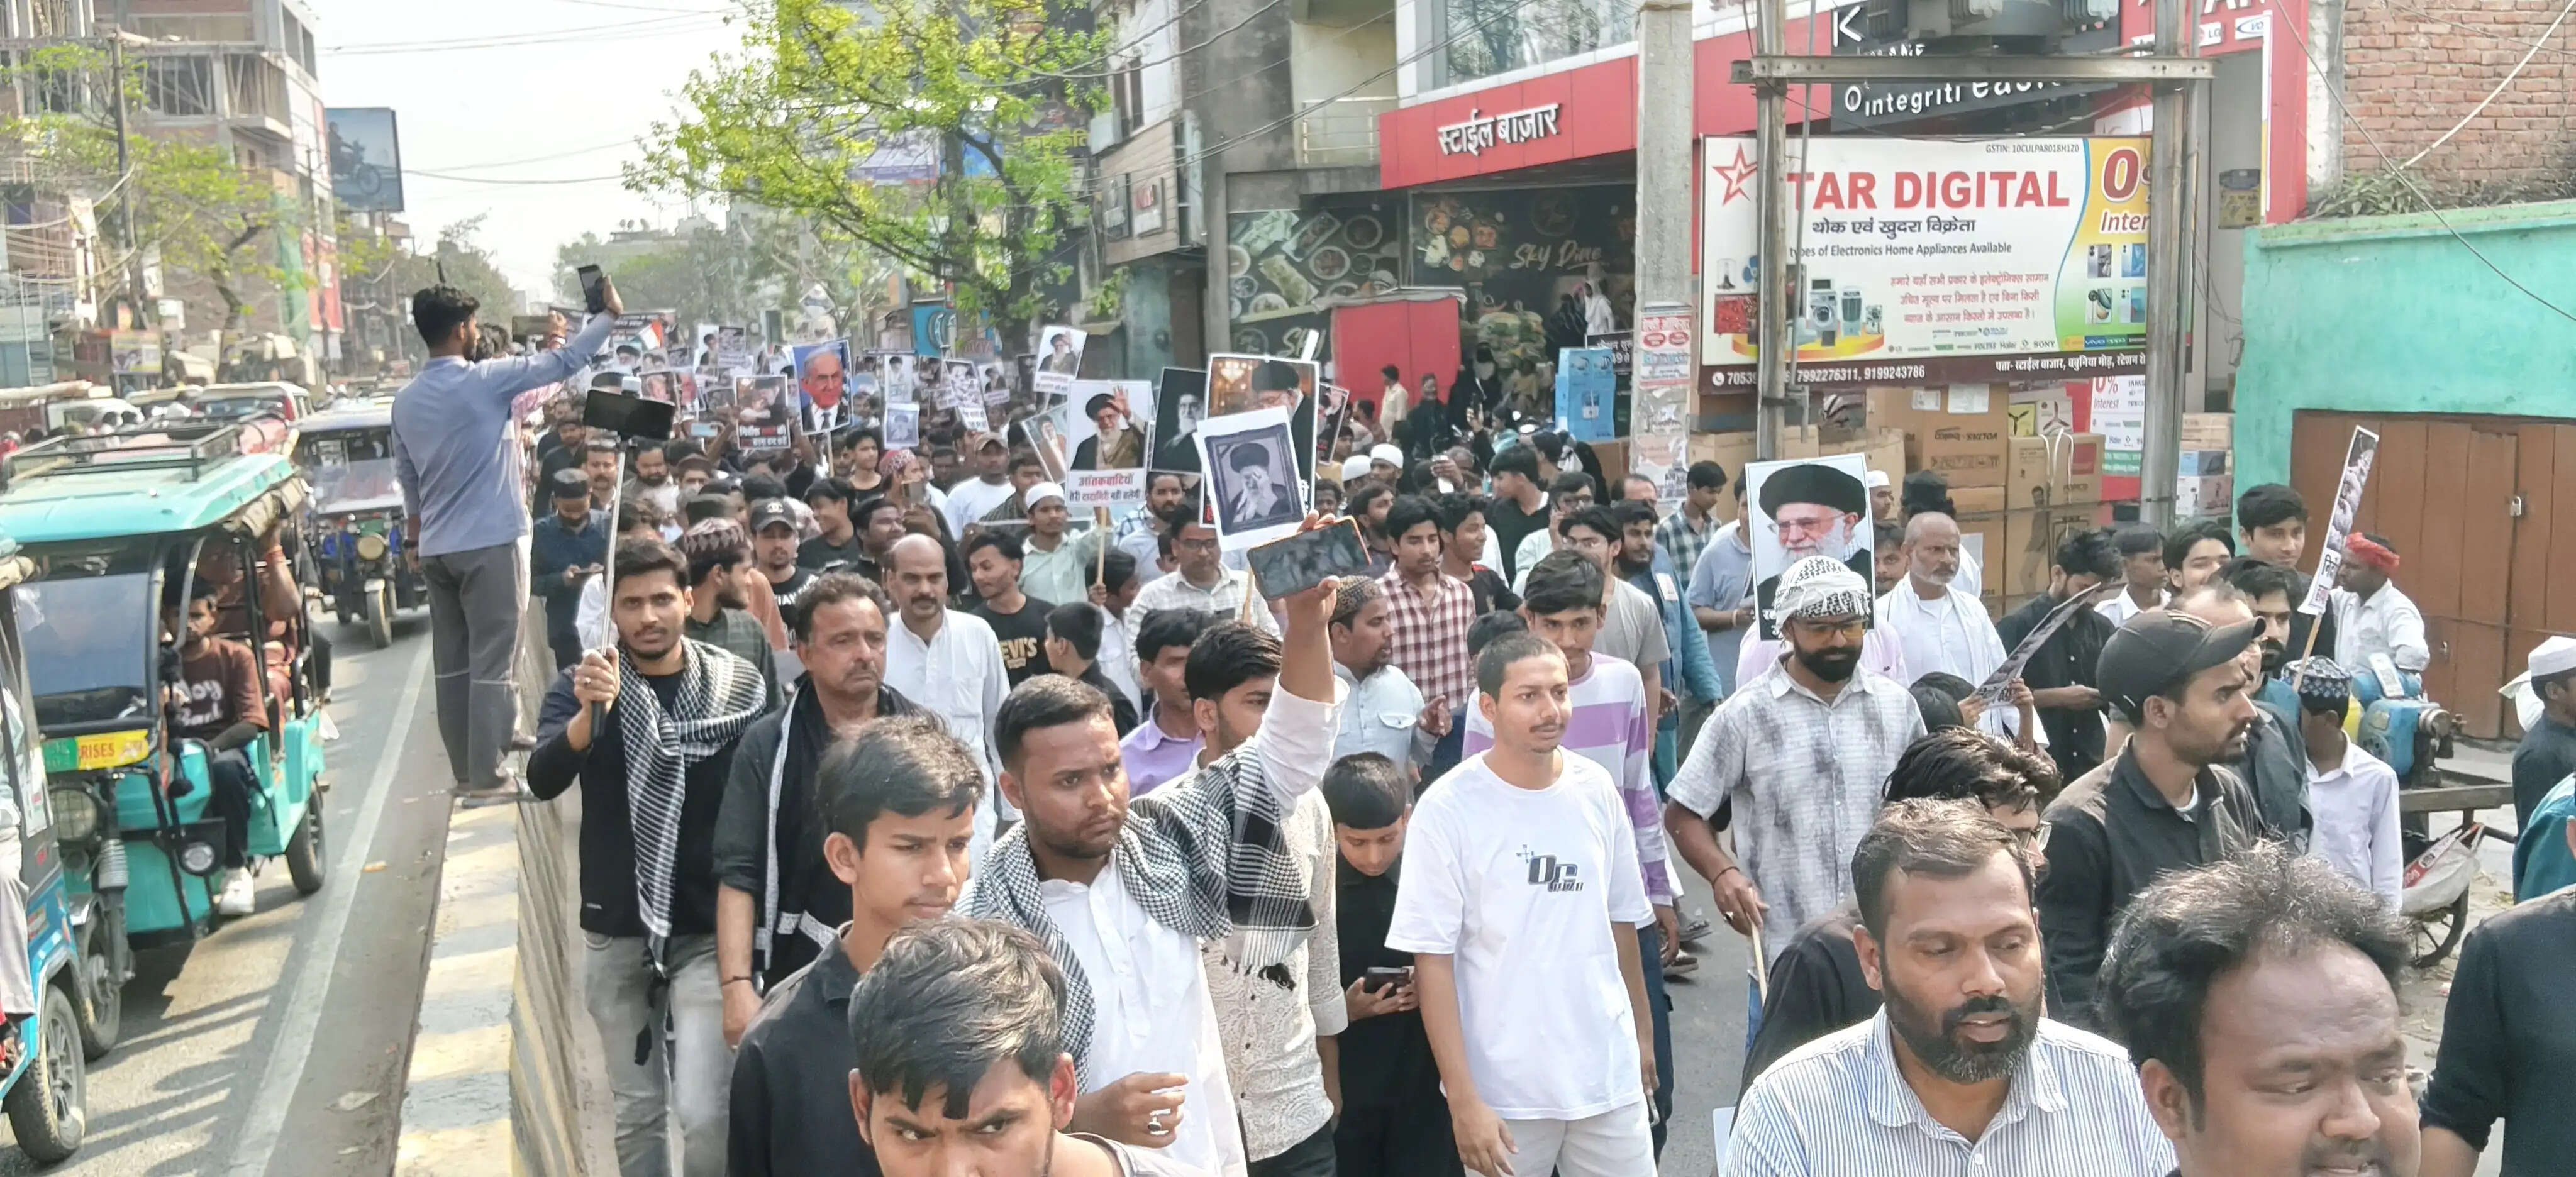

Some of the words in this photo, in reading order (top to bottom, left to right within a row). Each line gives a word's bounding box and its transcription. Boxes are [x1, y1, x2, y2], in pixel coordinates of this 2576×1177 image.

[1438, 108, 1495, 156] स्टाईल
[1985, 144, 2010, 153] GSTIN:
[1894, 170, 2070, 209] DIGITAL
[1812, 216, 1846, 235] थोक
[1852, 216, 1874, 234] एवं
[1879, 219, 1921, 240] खुदरा
[1926, 216, 1976, 235] विक्रेता
[2101, 211, 2150, 233] Inter
[1819, 245, 1828, 257] of
[1831, 243, 1882, 257] Electronics
[1885, 245, 1913, 256] Home
[1918, 242, 1967, 258] Appliances
[1969, 241, 2012, 255] Available
[1864, 365, 1926, 380] 9199243786
[2094, 397, 2119, 409] Interest
[999, 637, 1038, 660] EVI'S
